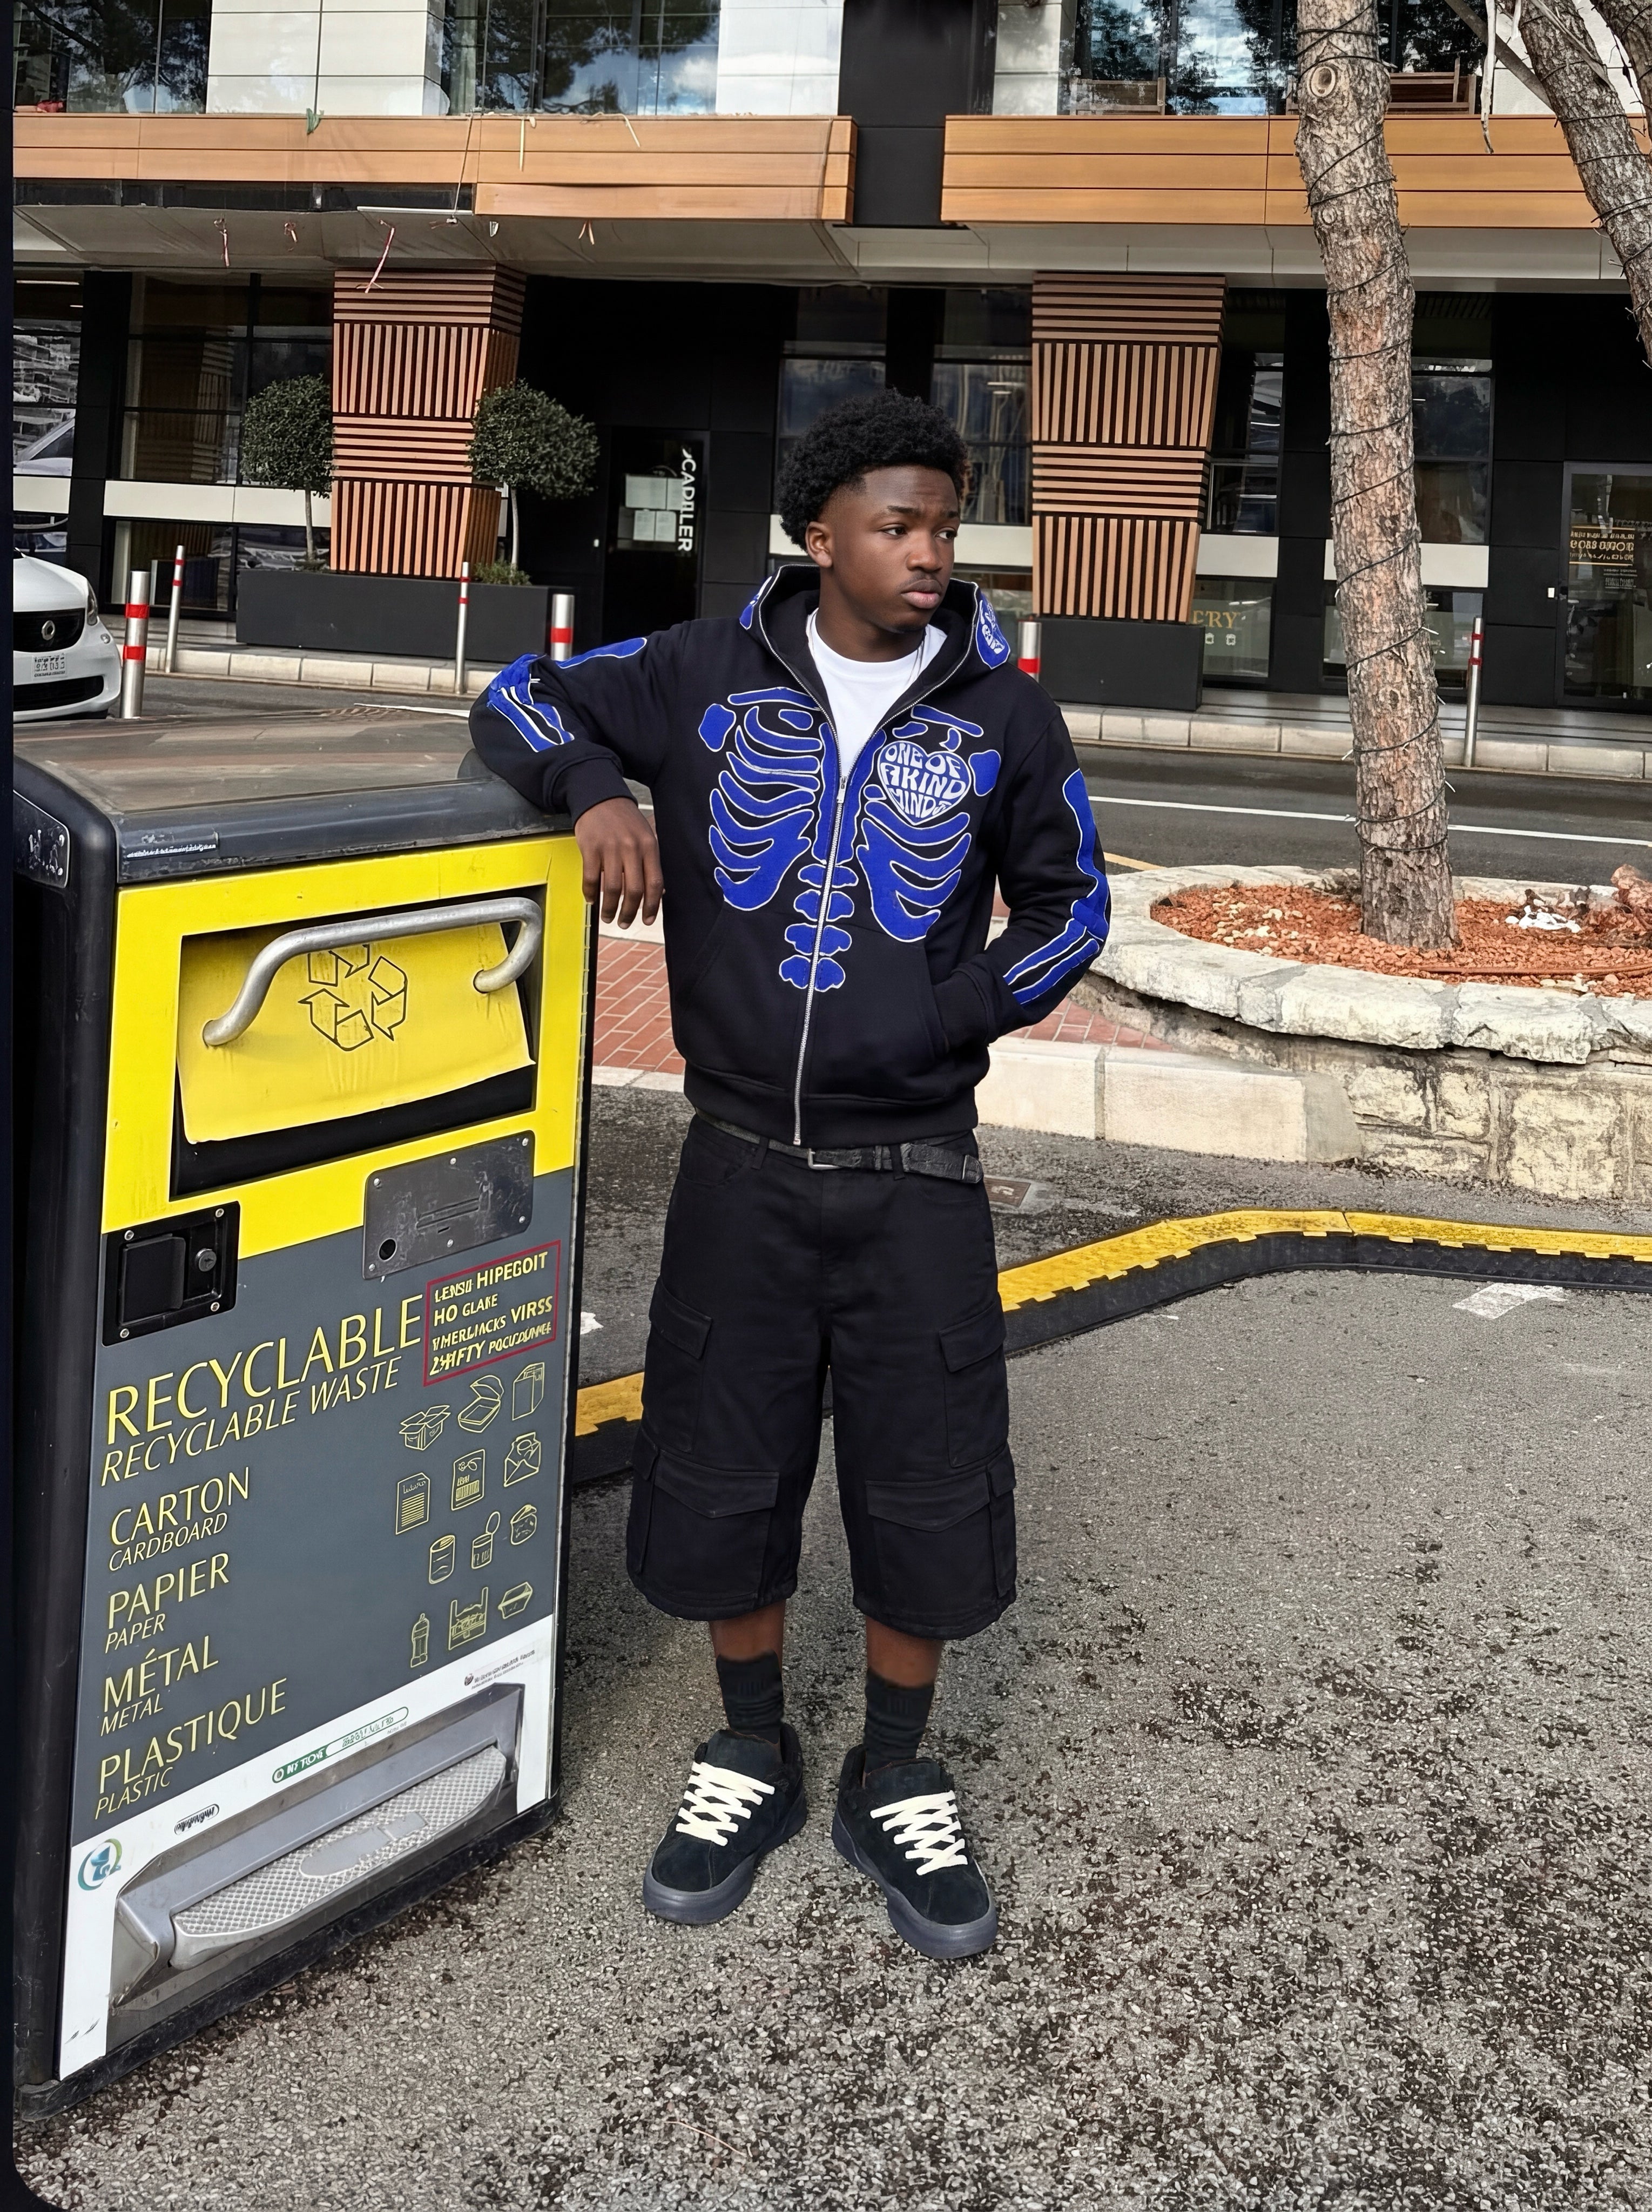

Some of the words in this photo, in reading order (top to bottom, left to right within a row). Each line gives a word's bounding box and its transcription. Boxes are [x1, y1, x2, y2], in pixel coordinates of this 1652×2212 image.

[885, 743, 923, 769] ONE
[925, 754, 961, 779] OF
[107, 1293, 423, 1446] RECYCLABLE
[100, 1391, 300, 1487] RECYCLABLE
[310, 1355, 403, 1415] WASTE
[109, 1512, 228, 1572] CARDBOARD
[110, 1466, 250, 1546] CARTON
[107, 1552, 230, 1630] PAPIER
[104, 1613, 166, 1654] PAPER
[103, 1634, 219, 1713] MÉTAL
[98, 1677, 288, 1795] PLASTIQUE
[99, 1694, 164, 1737] METAL
[94, 1766, 171, 1820] PLASTIC
